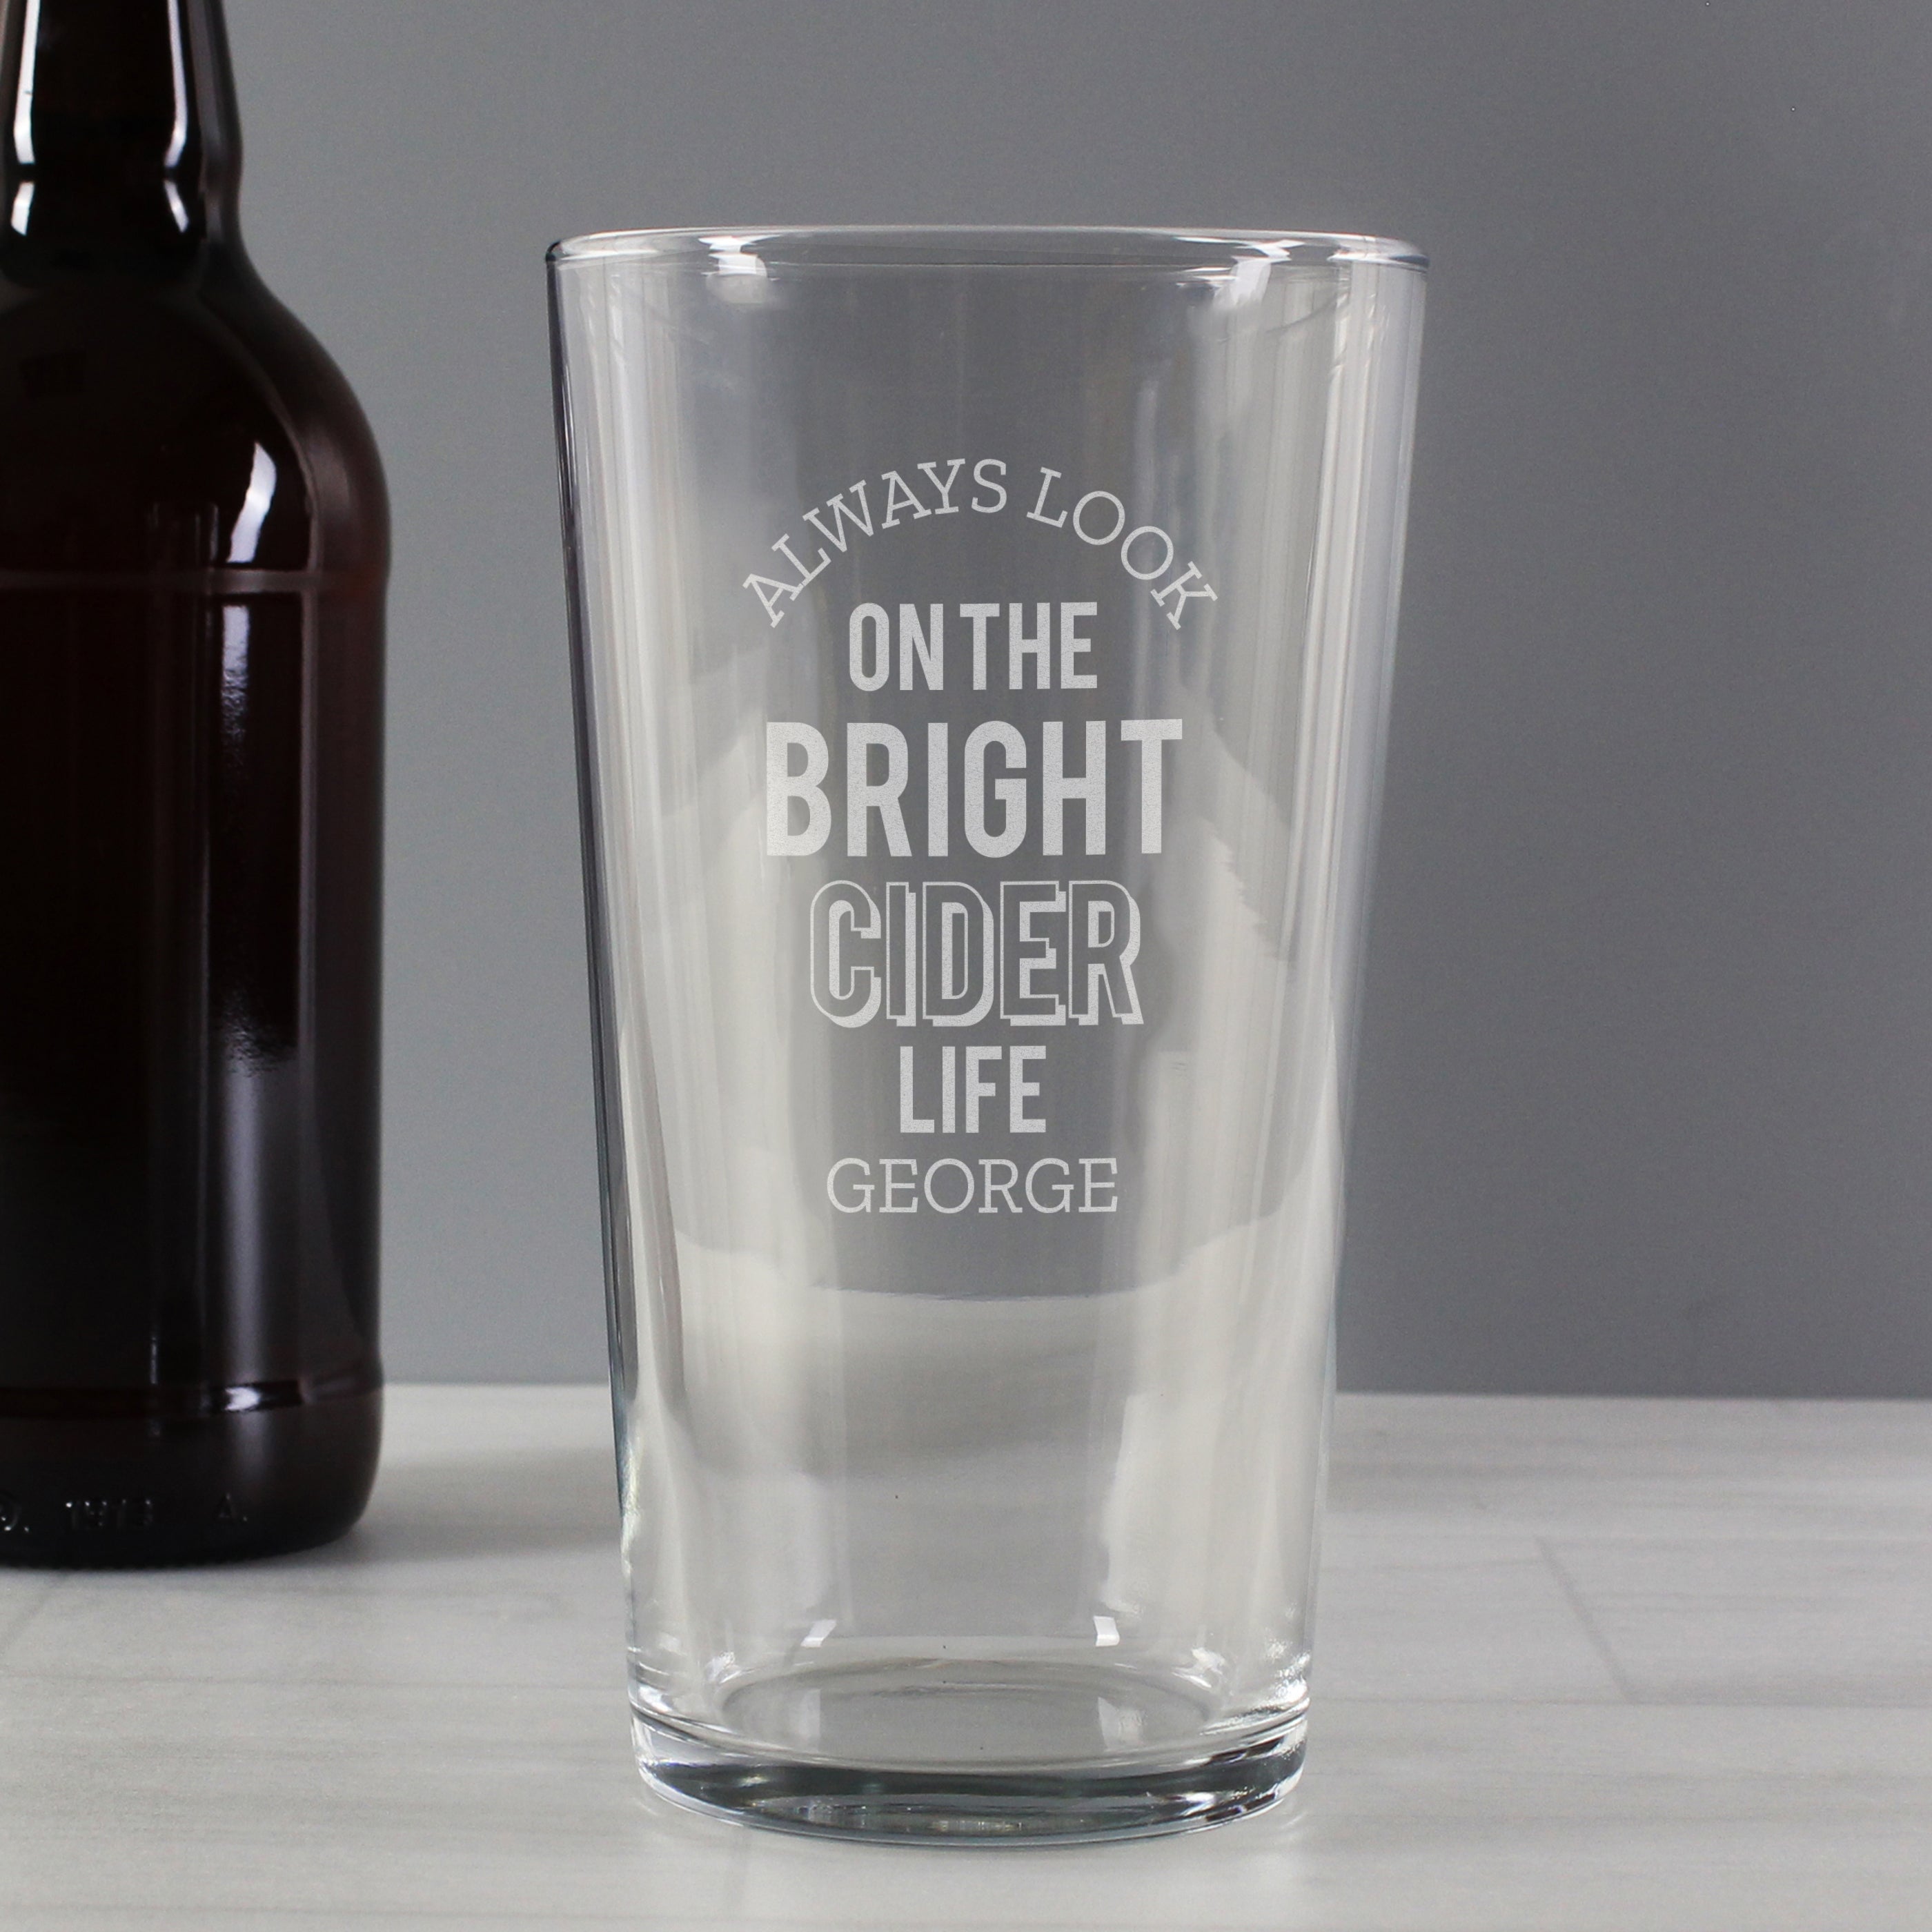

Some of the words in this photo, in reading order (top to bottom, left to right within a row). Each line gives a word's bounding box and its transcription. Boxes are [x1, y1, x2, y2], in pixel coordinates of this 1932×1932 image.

[742, 458, 1007, 628] ALWAYS
[1026, 466, 1218, 630] LOOK
[849, 602, 944, 691] ON
[959, 602, 1098, 691] THE
[766, 718, 1183, 858] BRIGHT
[810, 880, 1145, 1028] CIDER
[900, 1045, 1047, 1133] LIFE
[827, 1157, 1118, 1214] GEORGE
